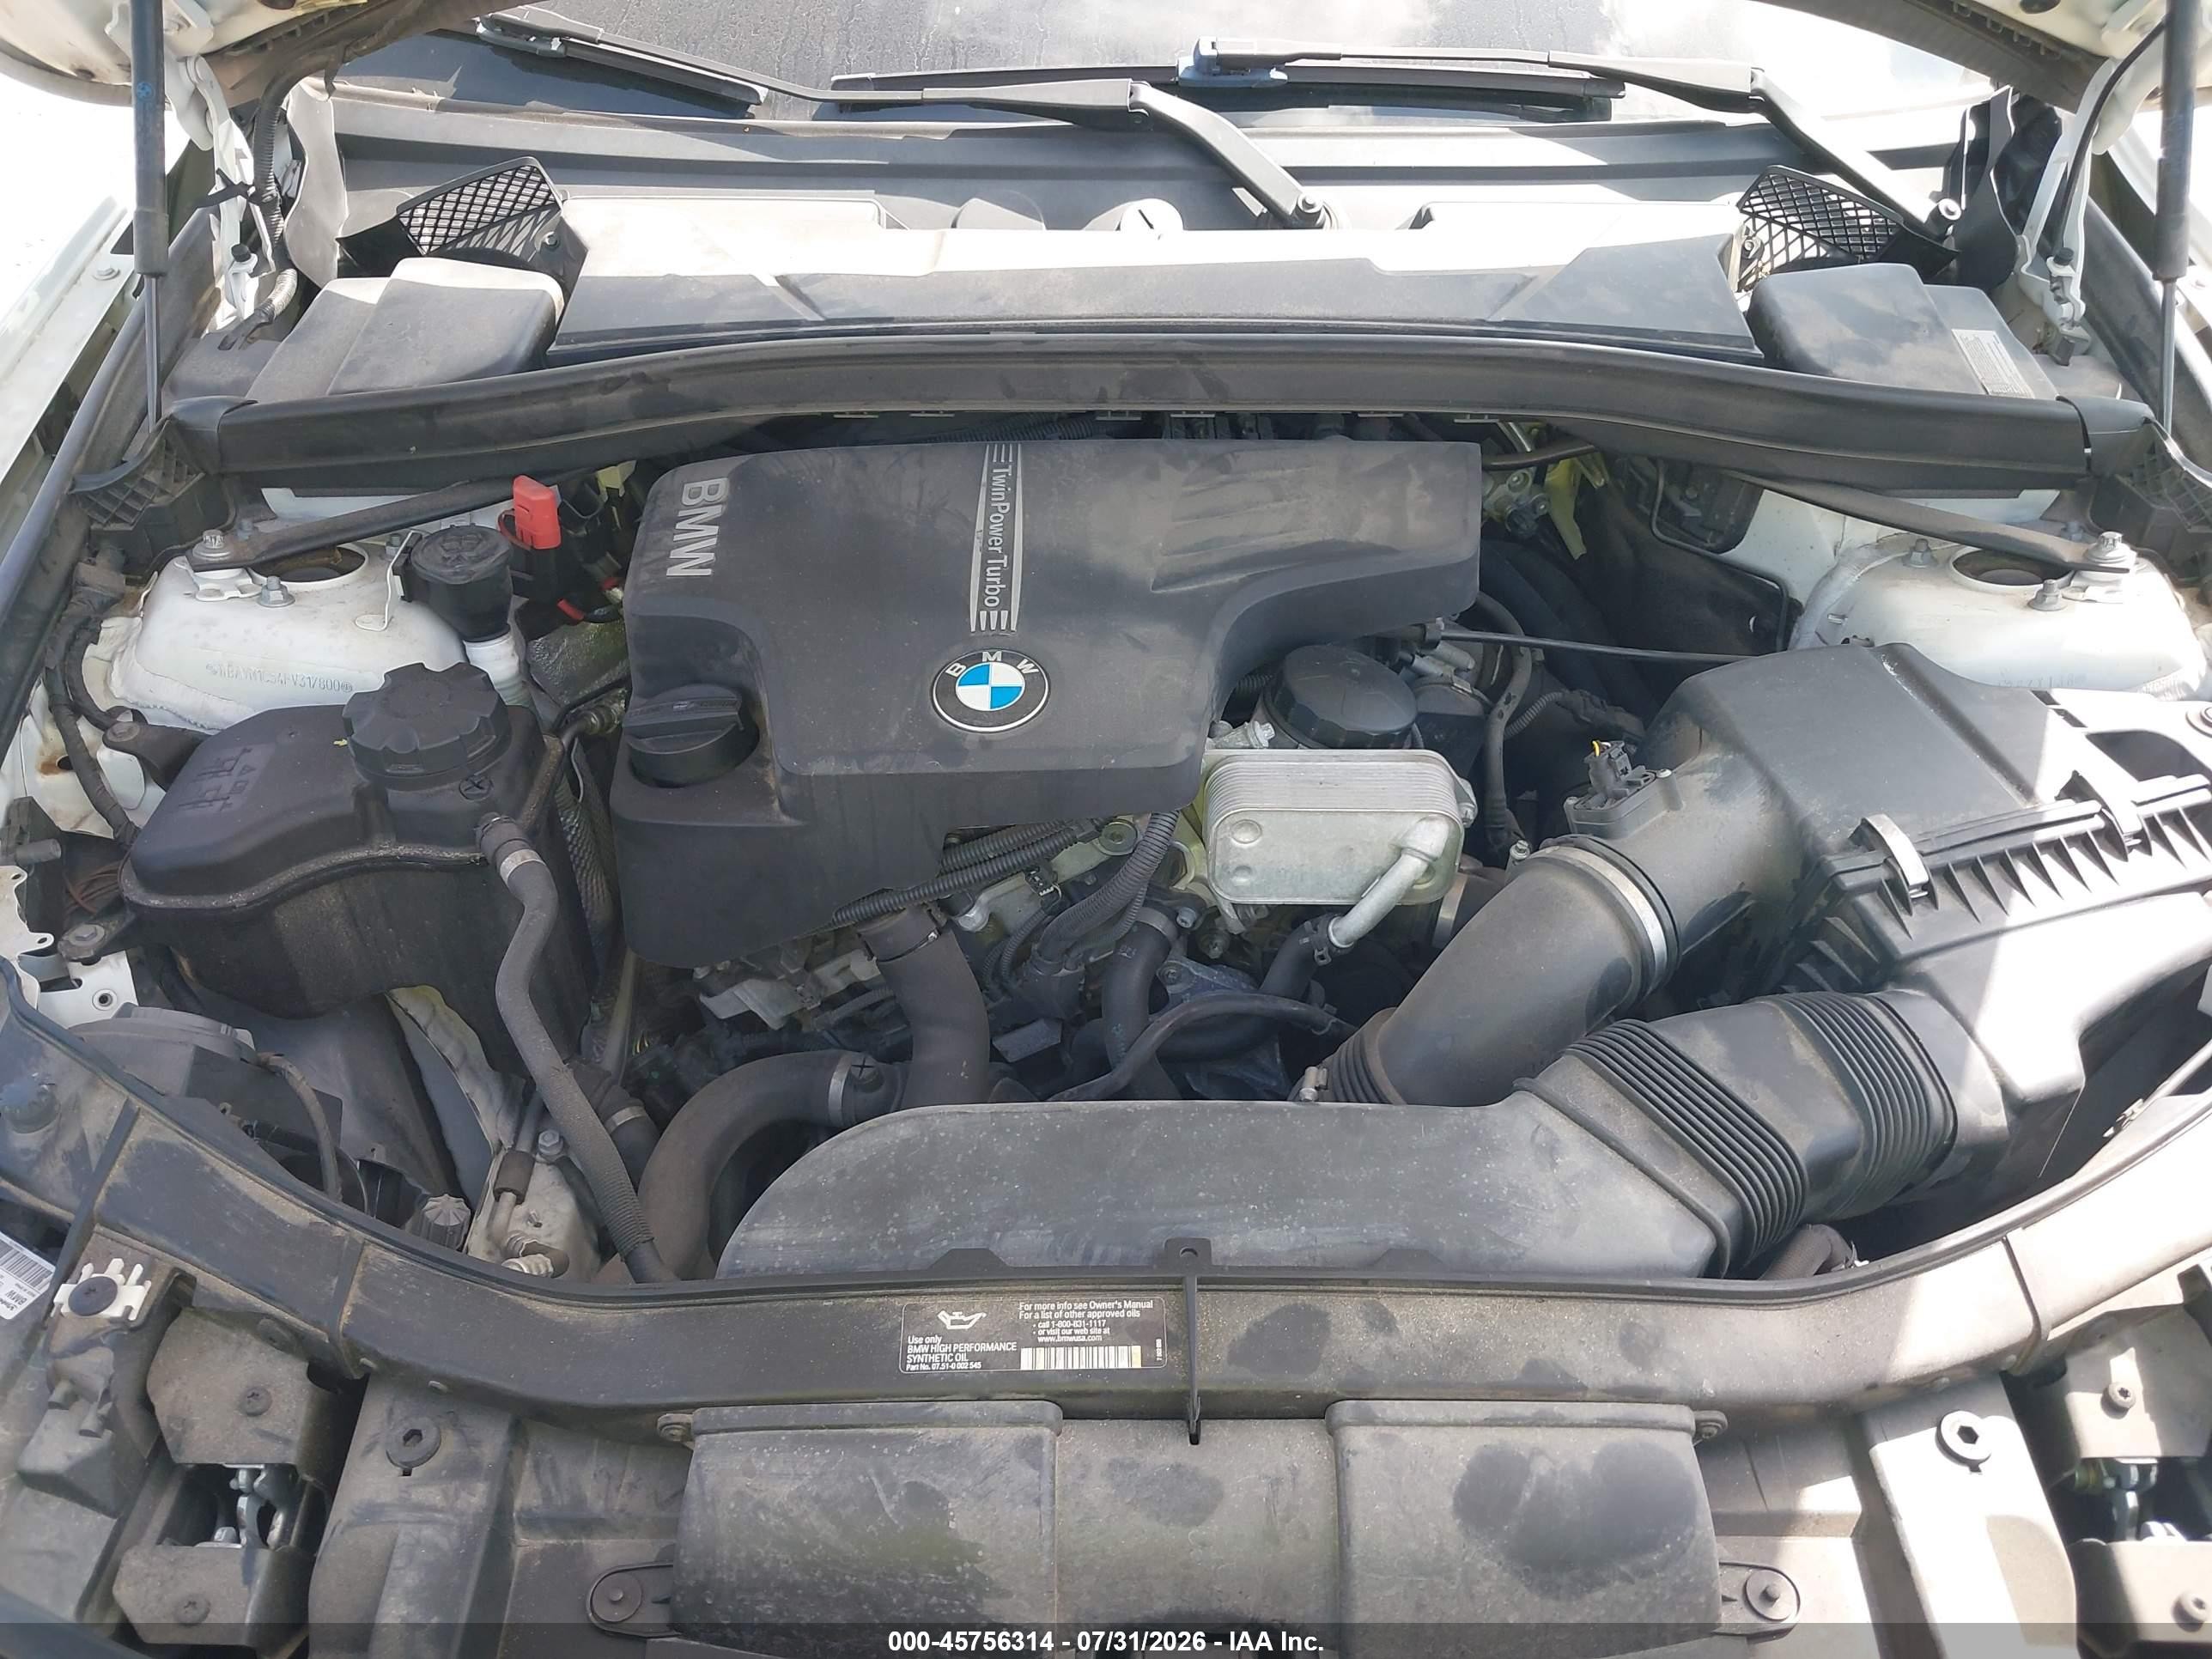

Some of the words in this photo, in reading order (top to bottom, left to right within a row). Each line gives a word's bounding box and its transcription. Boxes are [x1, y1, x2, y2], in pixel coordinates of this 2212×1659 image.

[665, 477, 730, 577] BMW
[945, 650, 1040, 678] BMW
[1018, 1302, 1032, 1311] For
[1056, 1301, 1073, 1310] info
[1089, 1300, 1122, 1310] Owner's
[1123, 1299, 1153, 1309] Manual
[1018, 1310, 1032, 1320] For
[1041, 1310, 1053, 1319] list
[1054, 1310, 1064, 1319] of
[1064, 1310, 1085, 1319] other
[1086, 1309, 1125, 1319] approved
[1126, 1309, 1141, 1318] oils
[1047, 1327, 1060, 1335] visit
[1073, 1327, 1089, 1335] web
[908, 1335, 924, 1345] Use
[924, 1334, 943, 1346] only
[907, 1344, 930, 1354] BMW
[930, 1343, 952, 1353] HIGH
[952, 1341, 1018, 1352] PERFORMANCE
[906, 1353, 954, 1364] SYNTHETIC
[954, 1352, 969, 1362] OIL
